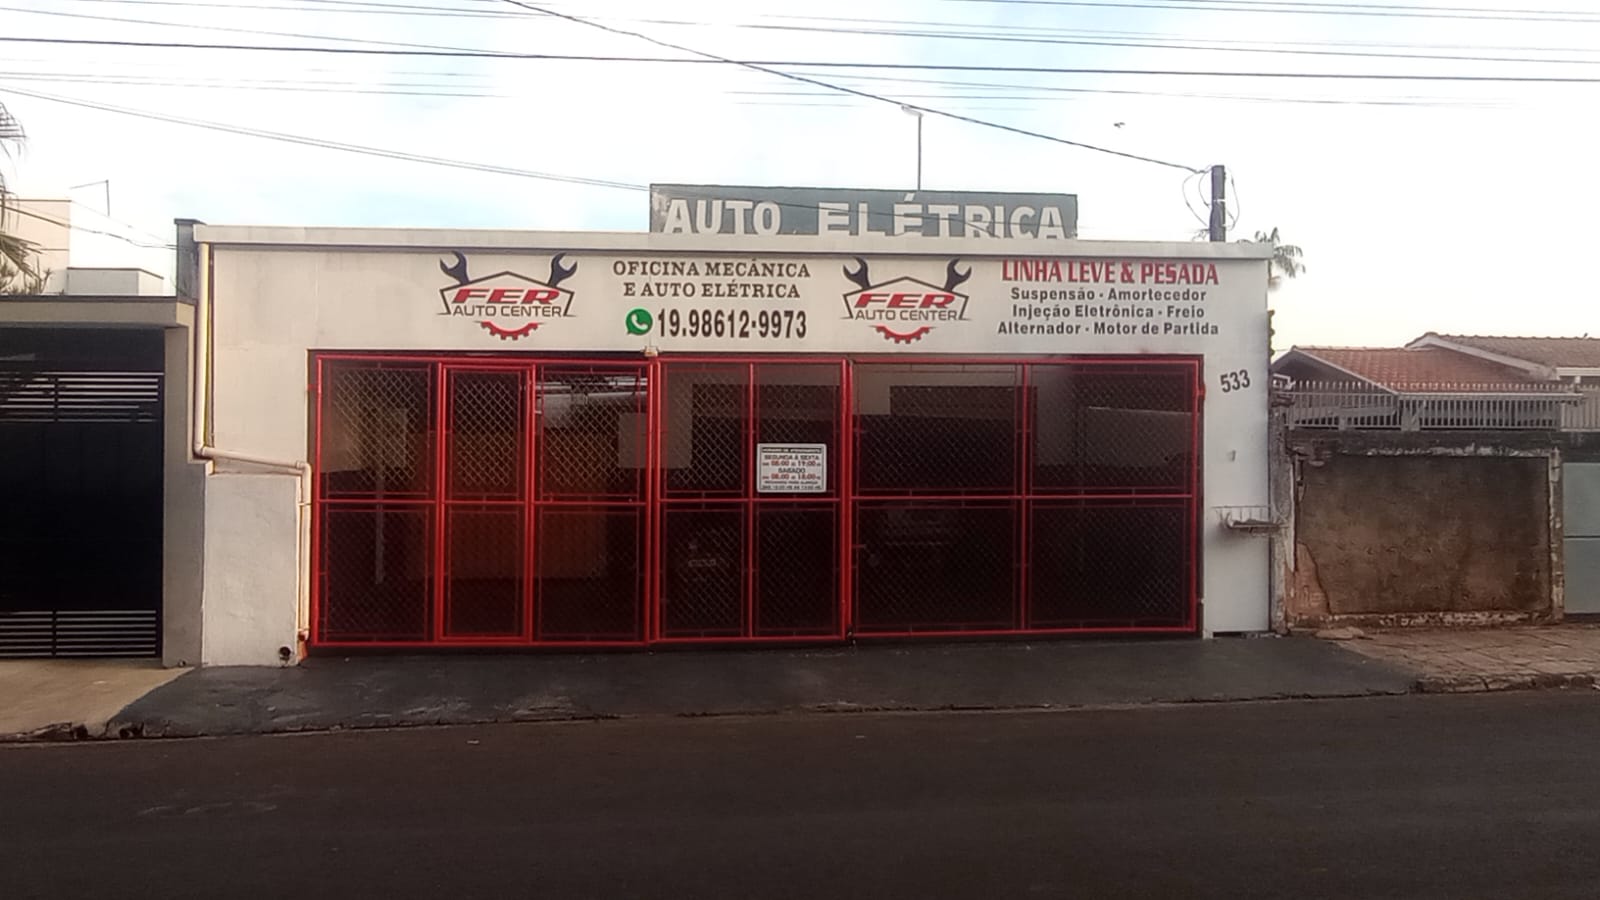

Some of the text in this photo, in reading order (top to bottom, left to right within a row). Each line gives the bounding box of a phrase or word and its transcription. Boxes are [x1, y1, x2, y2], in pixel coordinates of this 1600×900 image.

[663, 193, 1067, 240] AUTO ELÉTRICA
[613, 258, 811, 278] OFICINA MECÂNICA
[1002, 259, 1219, 285] LINHA LEVE & PESADA
[452, 289, 560, 305] FER
[623, 279, 801, 299] E AUTO ELÉTRICA
[1011, 287, 1095, 304] Suspensão
[1108, 288, 1207, 301] Amortecedor
[854, 293, 955, 309] FER
[453, 305, 562, 317] AUTO CENTER
[855, 309, 958, 321] AUTO CENTER
[1013, 304, 1071, 321] Injeção
[1075, 304, 1154, 318] Eletrônica
[1167, 305, 1205, 318] Freio
[998, 321, 1081, 335] Alternador
[1094, 322, 1137, 335] Motor
[1141, 322, 1159, 335] de
[1163, 322, 1219, 335] Partida
[1220, 369, 1251, 393] 533
